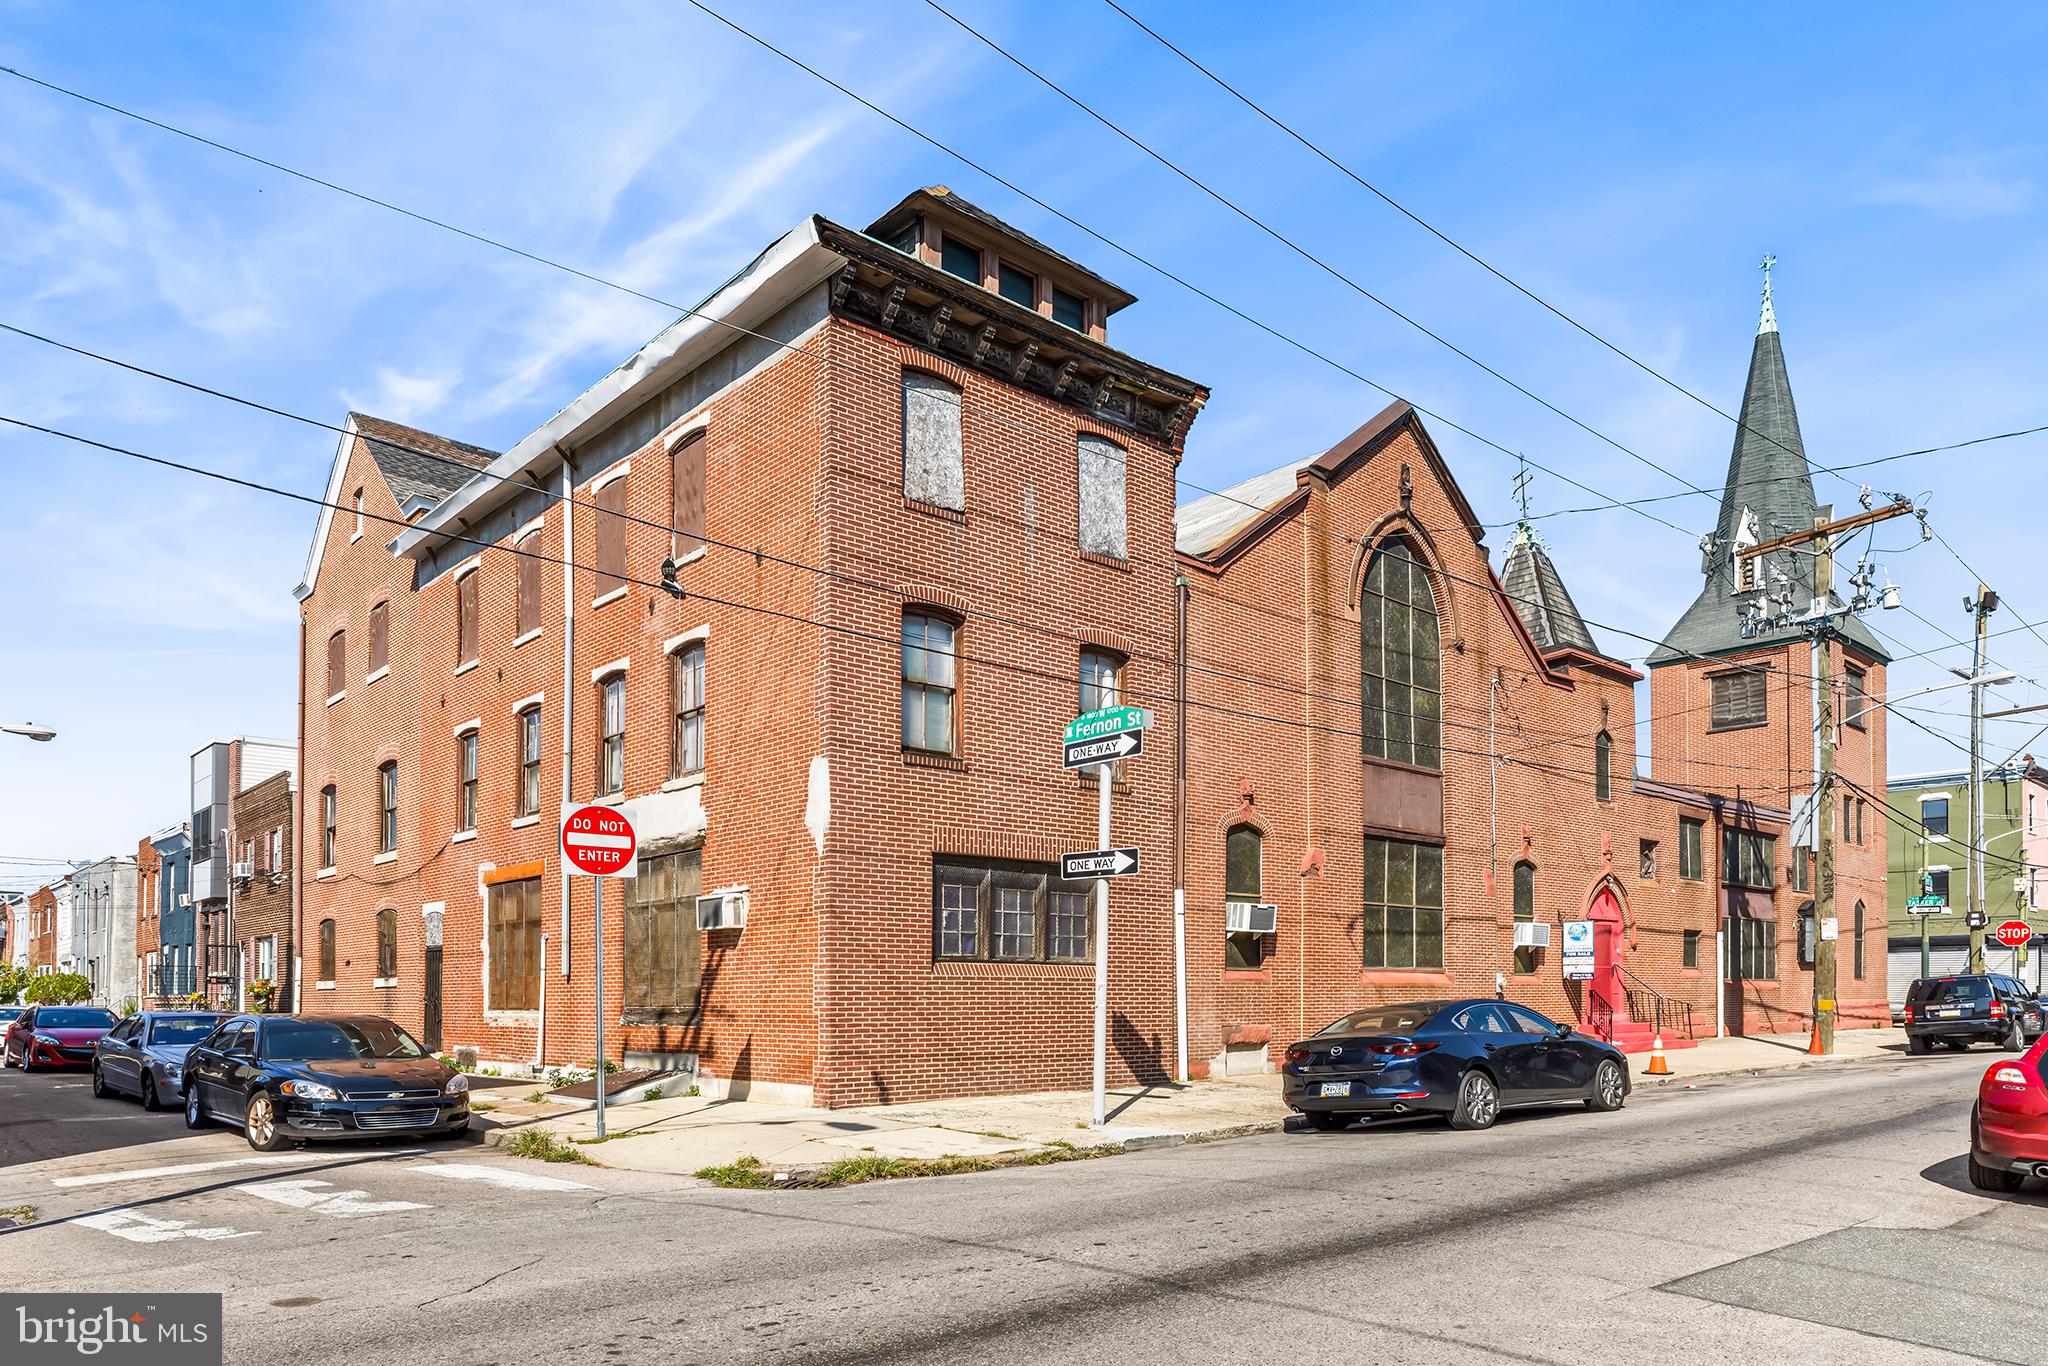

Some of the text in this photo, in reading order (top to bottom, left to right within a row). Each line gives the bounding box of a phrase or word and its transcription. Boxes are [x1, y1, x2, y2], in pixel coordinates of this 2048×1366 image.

[1098, 708, 1106, 718] W
[1075, 711, 1142, 738] Fernon St
[573, 818, 625, 833] DO NOT
[578, 849, 620, 863] ENTER
[1069, 857, 1116, 872] ONE WAY
[1998, 928, 2030, 939] STOP
